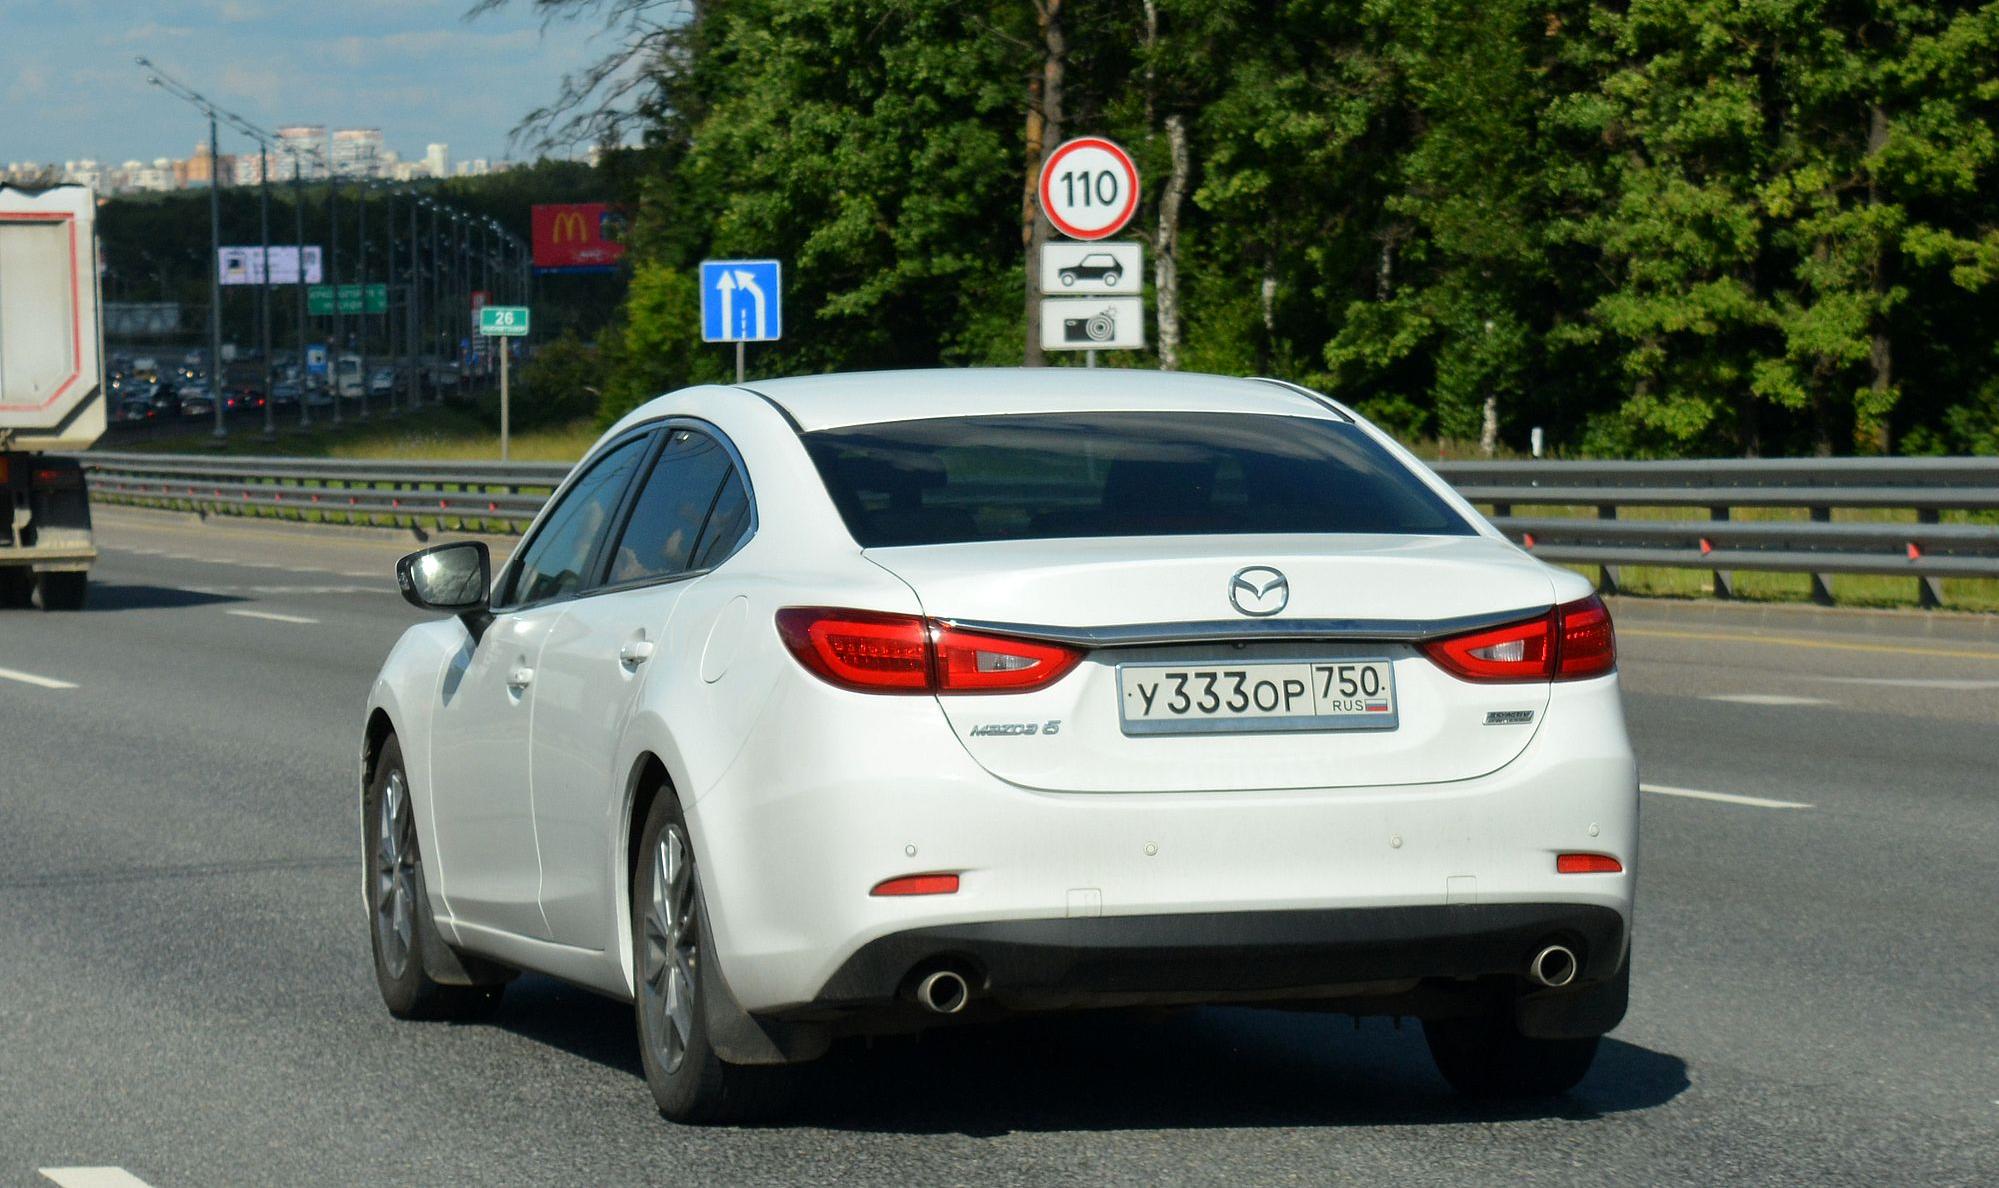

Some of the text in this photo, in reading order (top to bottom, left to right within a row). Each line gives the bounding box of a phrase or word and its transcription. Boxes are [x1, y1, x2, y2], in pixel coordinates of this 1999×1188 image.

[1060, 170, 1118, 207] 110
[495, 311, 514, 325] 26
[1315, 665, 1379, 698] 750
[1332, 699, 1364, 711] RUS
[1042, 720, 1062, 735] 6
